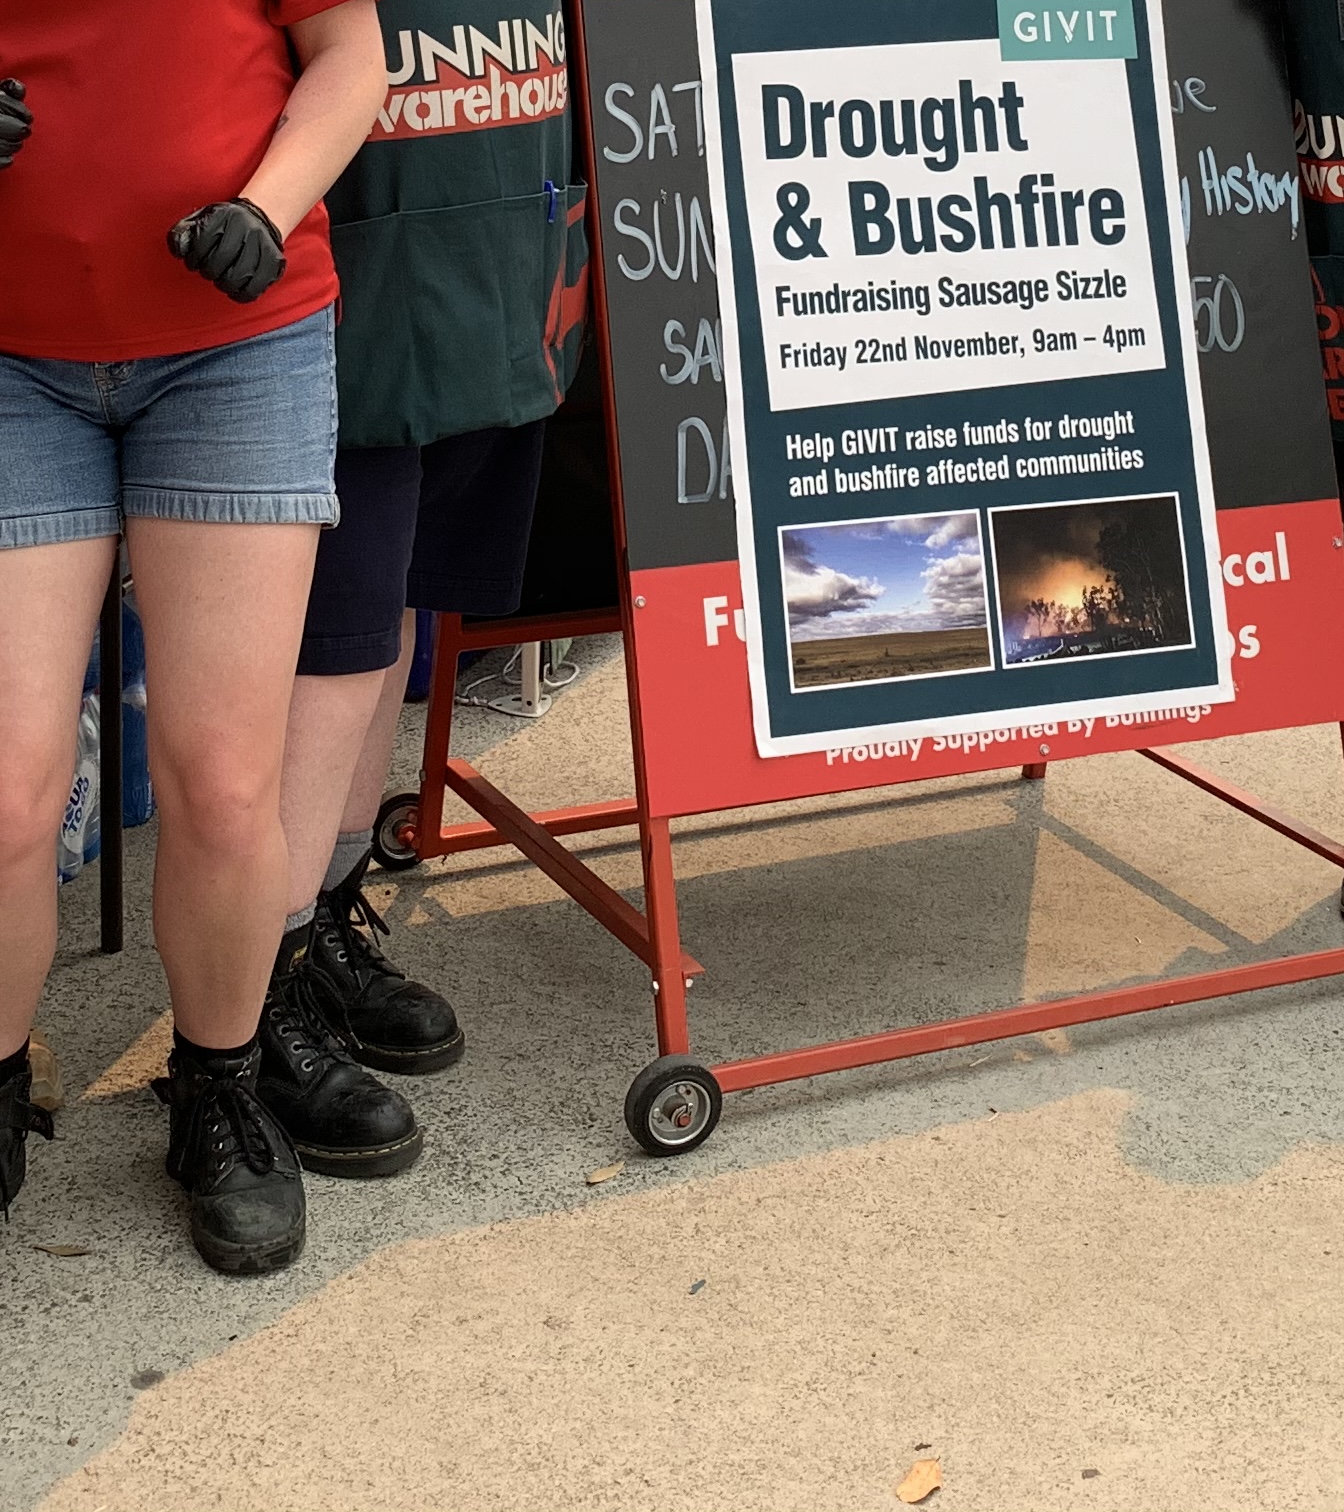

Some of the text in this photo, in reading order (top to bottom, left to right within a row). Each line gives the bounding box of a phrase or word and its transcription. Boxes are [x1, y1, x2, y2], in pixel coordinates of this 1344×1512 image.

[1013, 10, 1117, 43] GIVIT
[604, 82, 704, 164] SAT
[761, 79, 1028, 172] Drought
[773, 181, 829, 261] &
[848, 173, 1126, 256] Bushfire
[775, 269, 1127, 317] Fundraising Sausage Sizzle
[660, 317, 724, 385] SA
[780, 342, 847, 372] Friday
[855, 336, 907, 364] 22nd
[914, 332, 1026, 360] November,
[1033, 328, 1077, 353] 9am
[1102, 325, 1146, 353] 4pm
[786, 410, 1135, 463] Help GIVIT raise funds for drought
[789, 448, 1145, 498] and bushfire affected communities
[1219, 531, 1291, 587] cal
[826, 739, 923, 766] Proudly
[931, 720, 1059, 754] Supported
